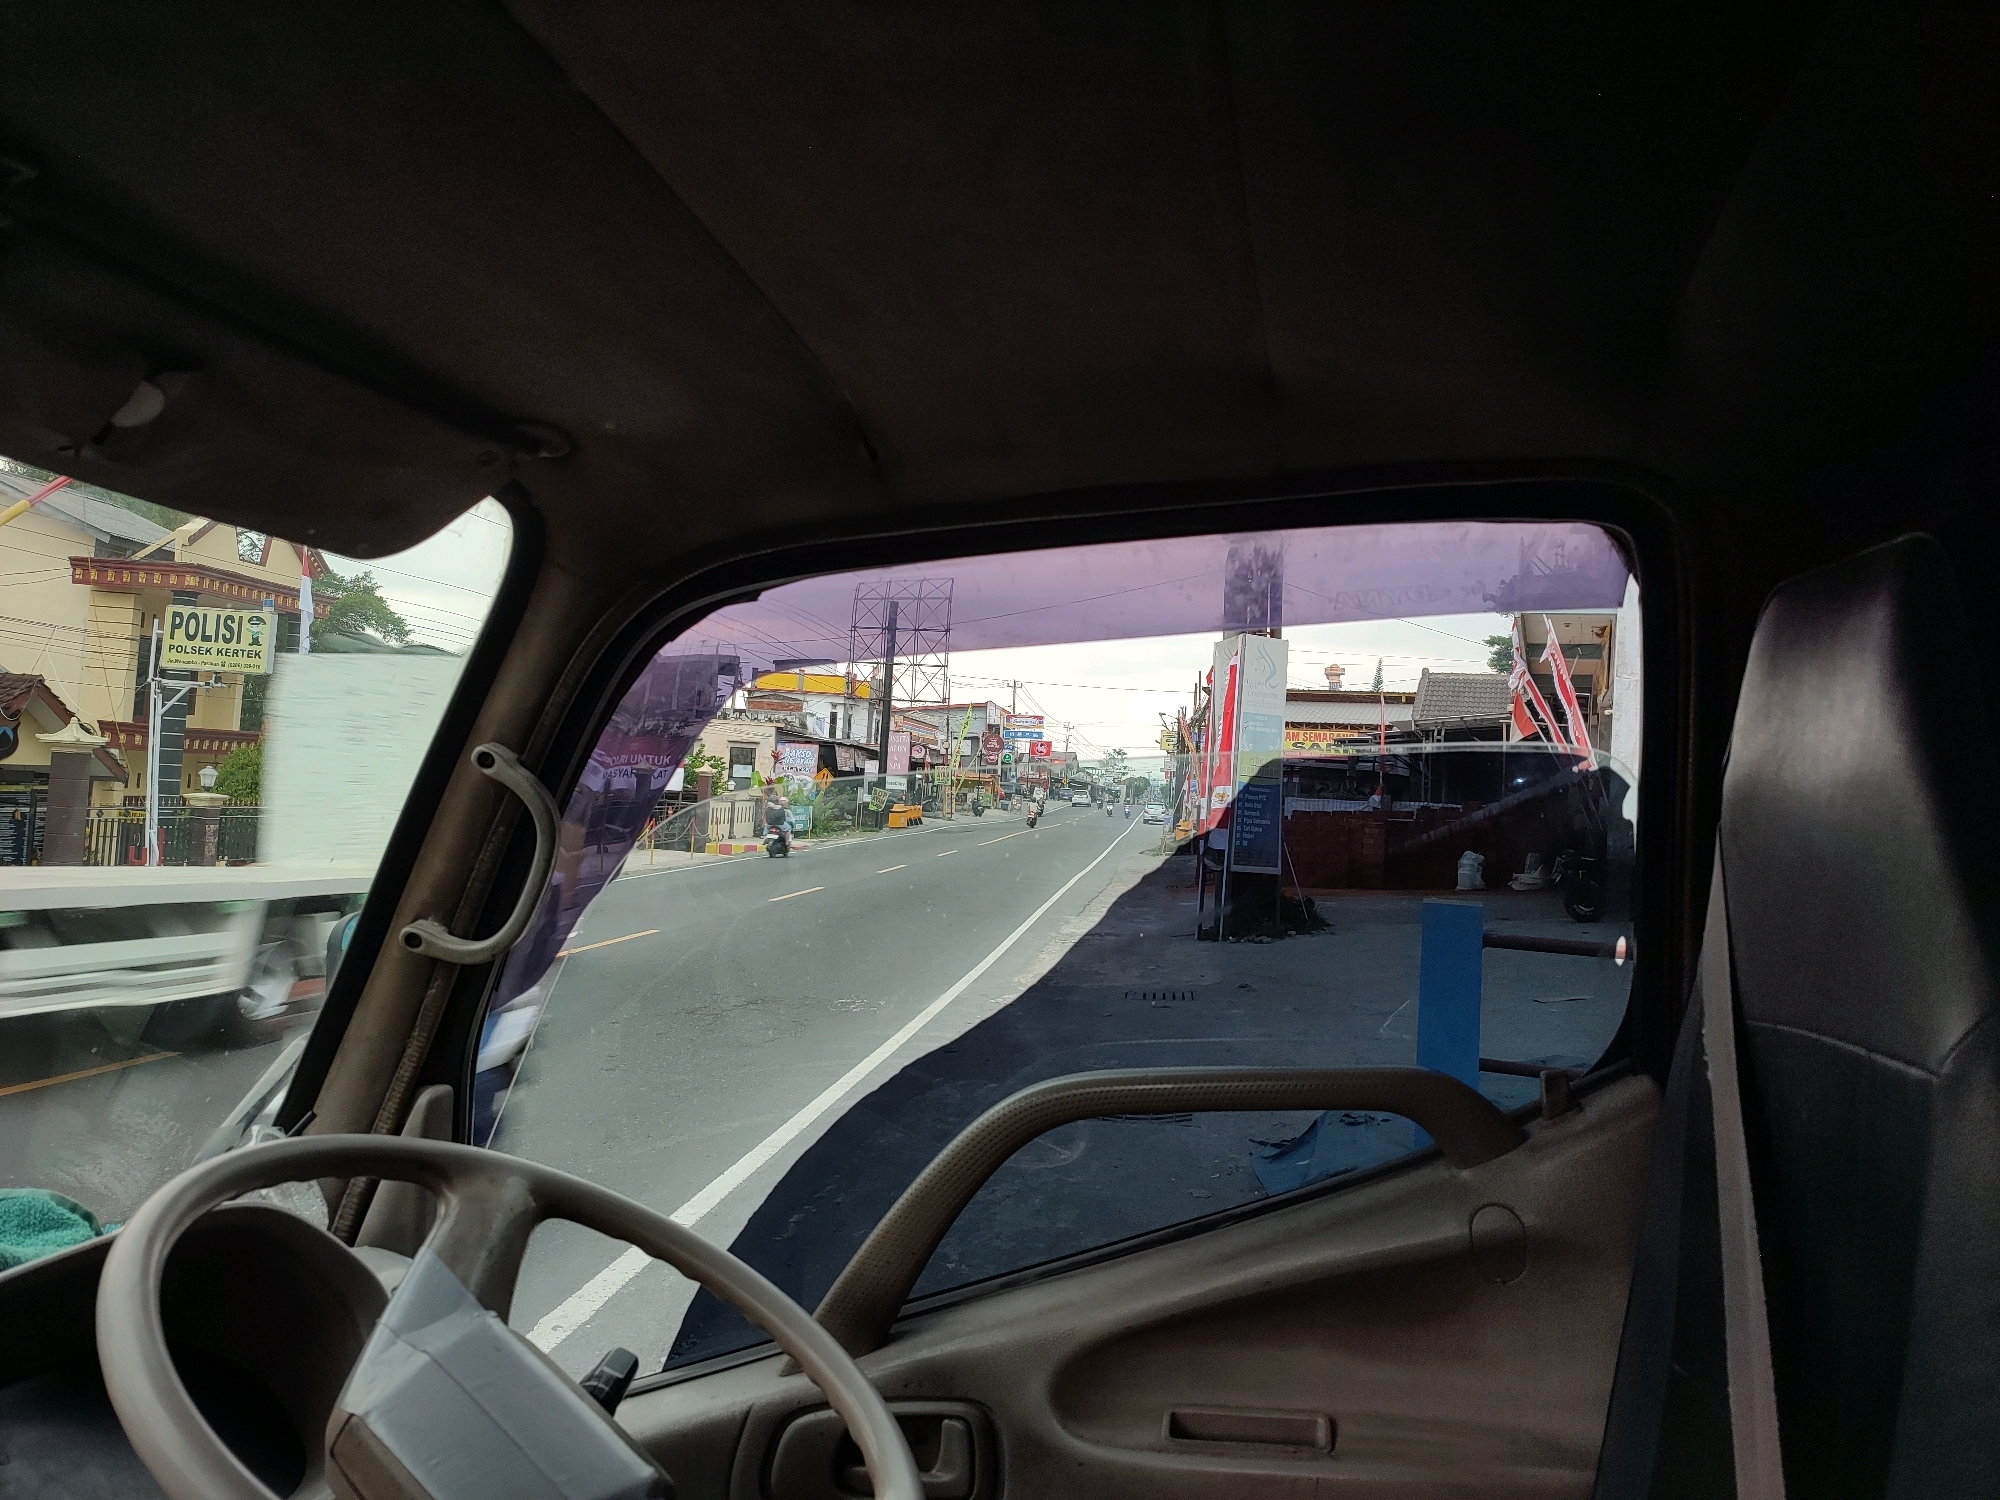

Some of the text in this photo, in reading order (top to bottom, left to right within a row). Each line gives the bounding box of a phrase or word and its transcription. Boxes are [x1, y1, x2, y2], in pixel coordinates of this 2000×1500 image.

[169, 611, 244, 645] POLISI
[168, 644, 262, 660] POLSEK KERTEK
[890, 744, 908, 753] ALON
[609, 754, 628, 767] OLRI
[630, 753, 672, 766] UNTUK
[889, 761, 902, 770] SPA
[602, 768, 669, 781] MASYARAT
[873, 789, 888, 799] SOP
